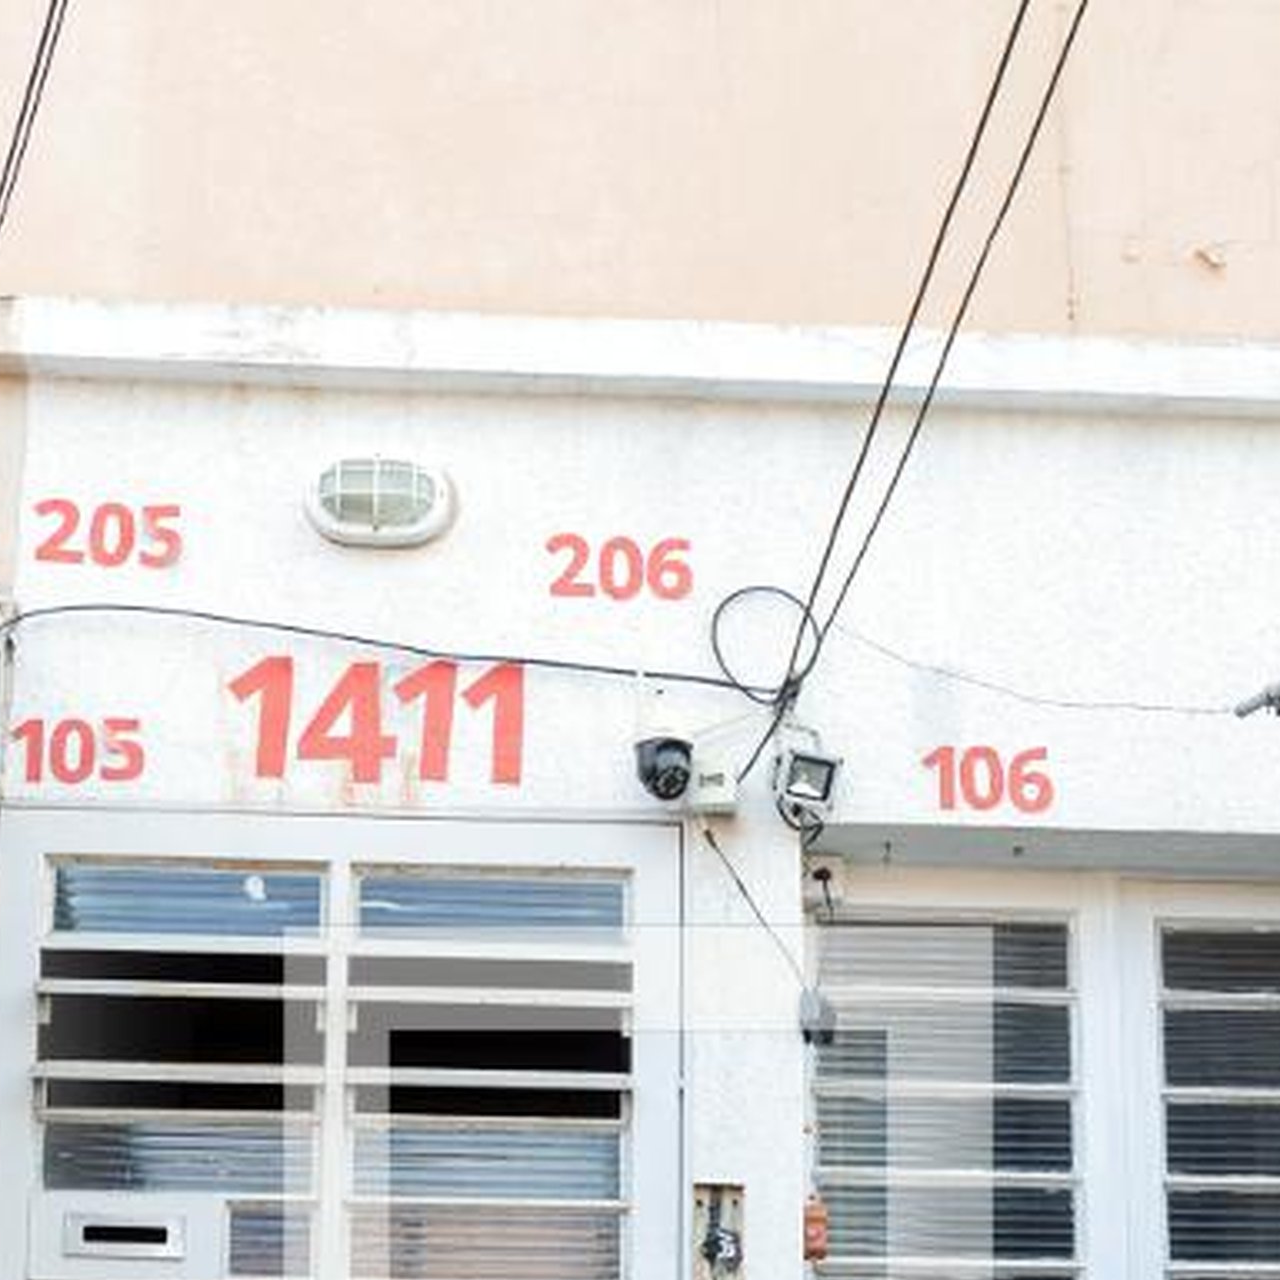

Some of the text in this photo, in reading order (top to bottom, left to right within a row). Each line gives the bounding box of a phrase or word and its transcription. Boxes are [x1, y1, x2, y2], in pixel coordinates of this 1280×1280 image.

[33, 498, 182, 568] 205
[545, 532, 693, 601] 206
[11, 718, 144, 784] 105
[228, 656, 524, 785] 1411
[922, 745, 1054, 812] 106
